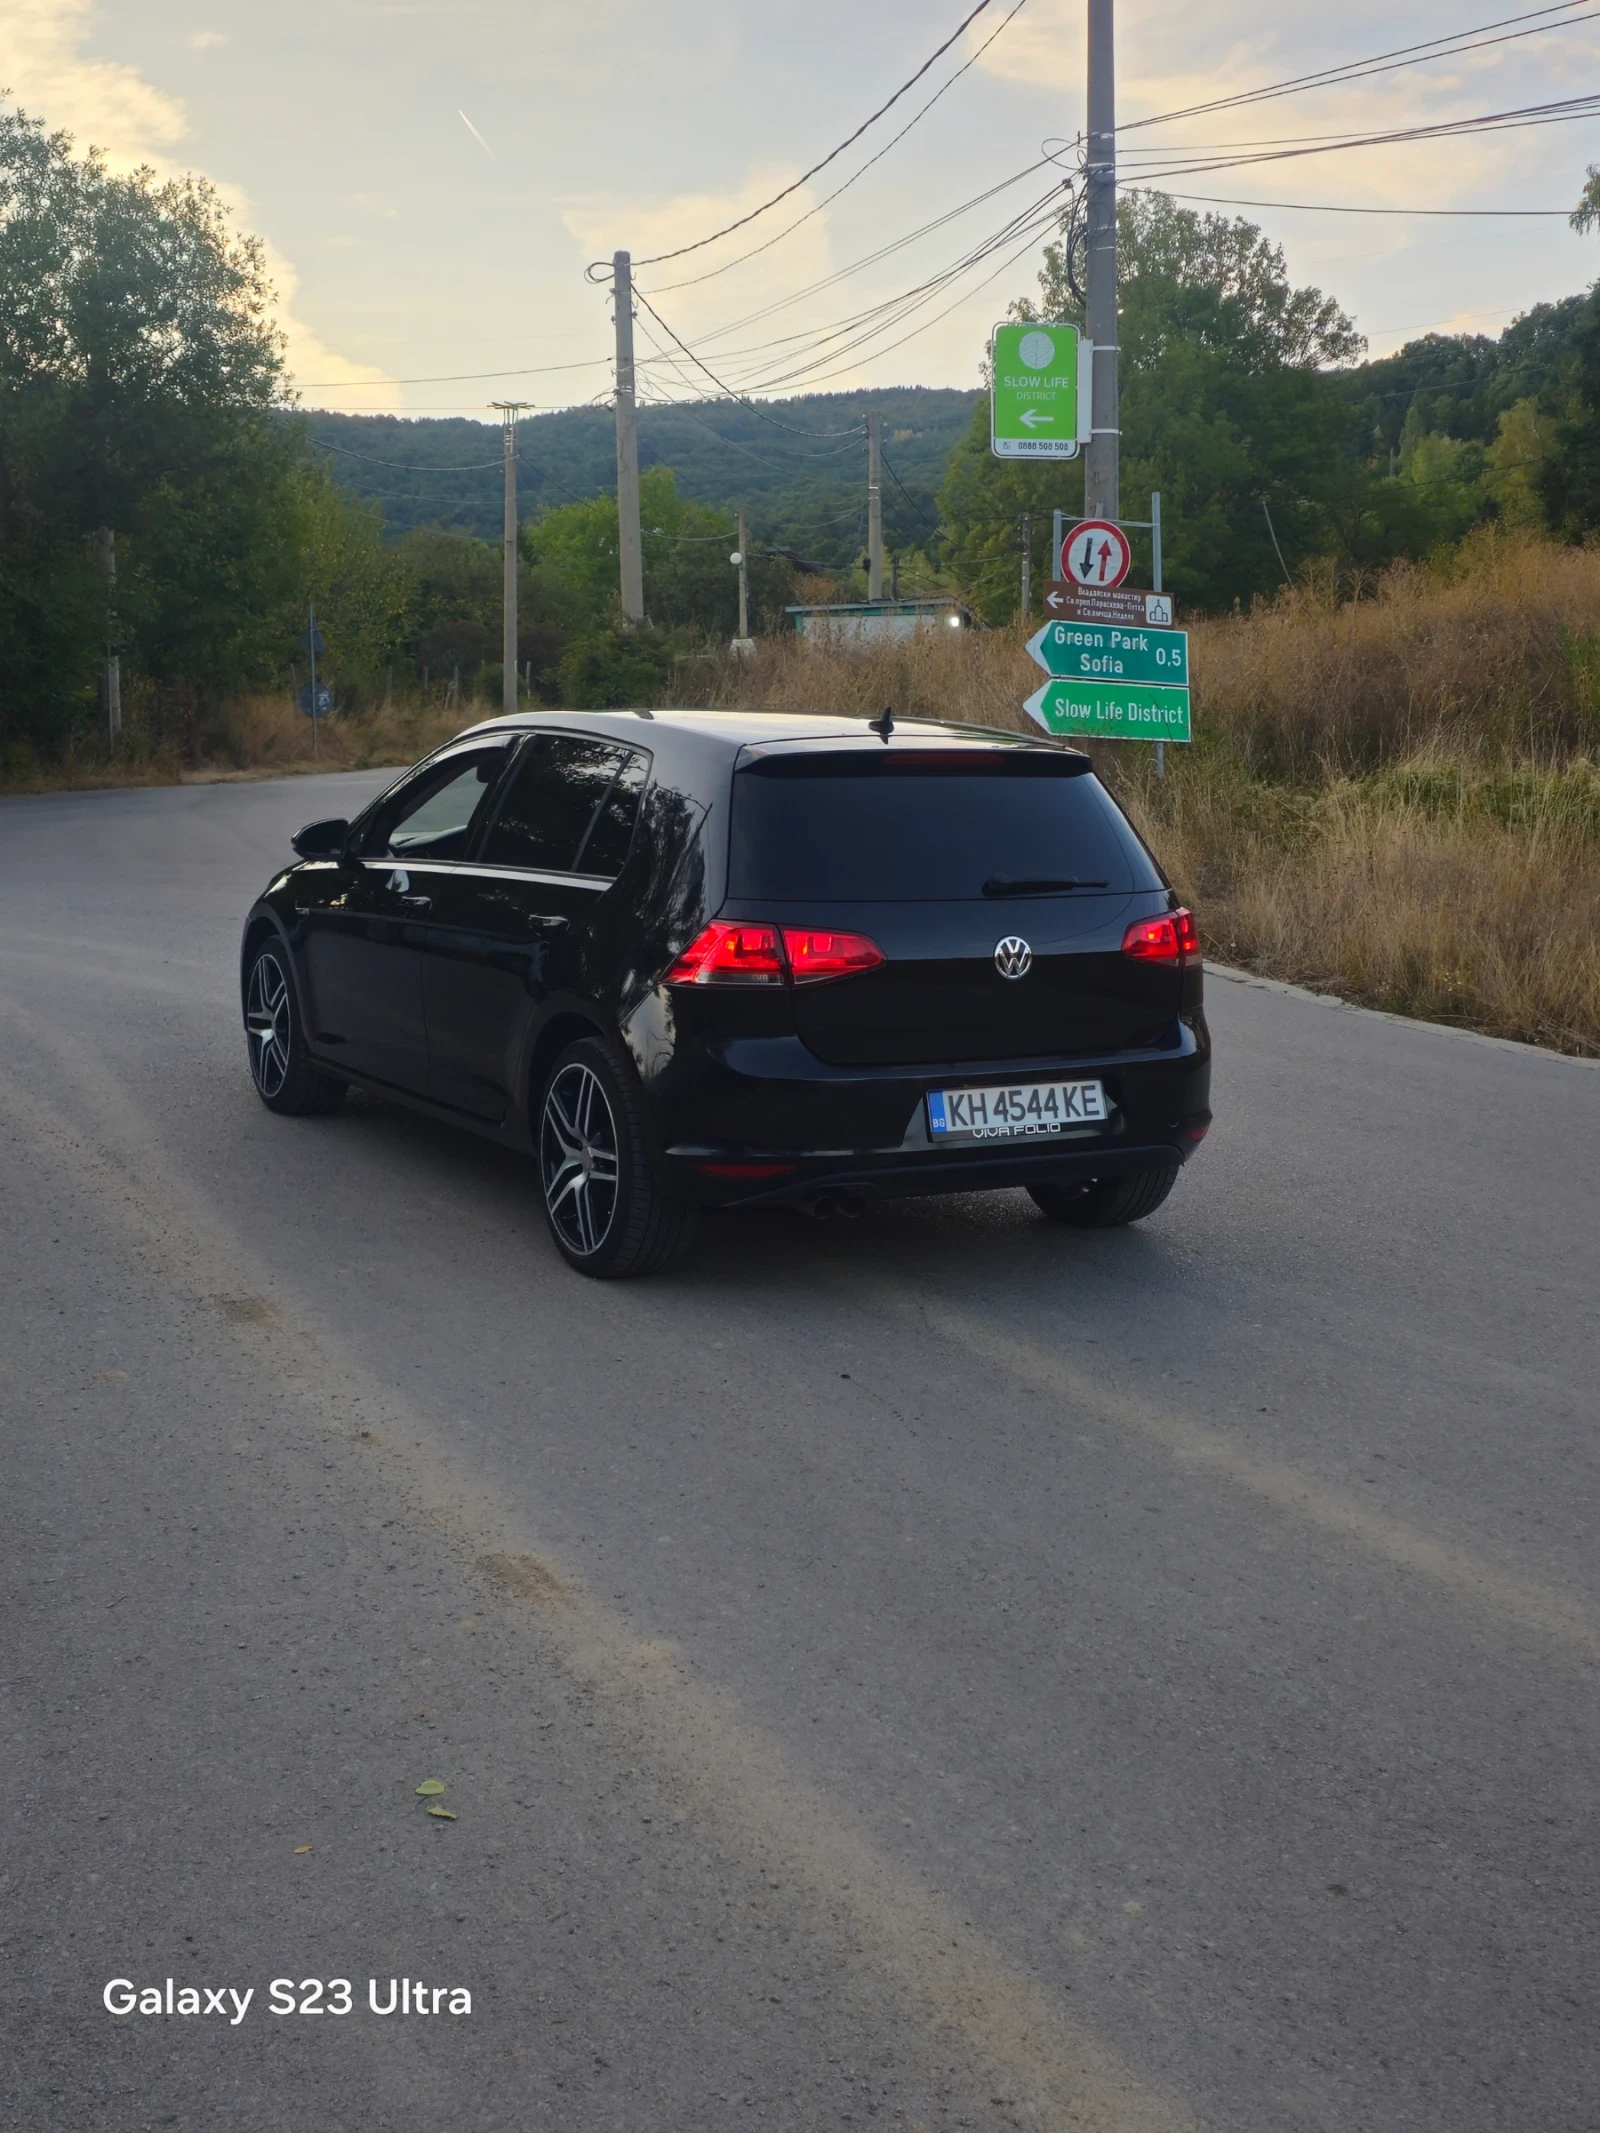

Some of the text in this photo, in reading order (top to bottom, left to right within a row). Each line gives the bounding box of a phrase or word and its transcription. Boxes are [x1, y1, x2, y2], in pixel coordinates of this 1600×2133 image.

[1004, 376, 1069, 388] SLOW LIFE
[1016, 391, 1057, 401] DISTRICT
[1018, 442, 1069, 451] 0888 508 508
[1054, 626, 1148, 651] Green Park
[1080, 653, 1124, 674] Sofia
[1155, 647, 1181, 668] 0,5
[1055, 698, 1184, 724] Slow Life District
[932, 1118, 945, 1128] BG
[972, 1126, 1010, 1139] VIVA
